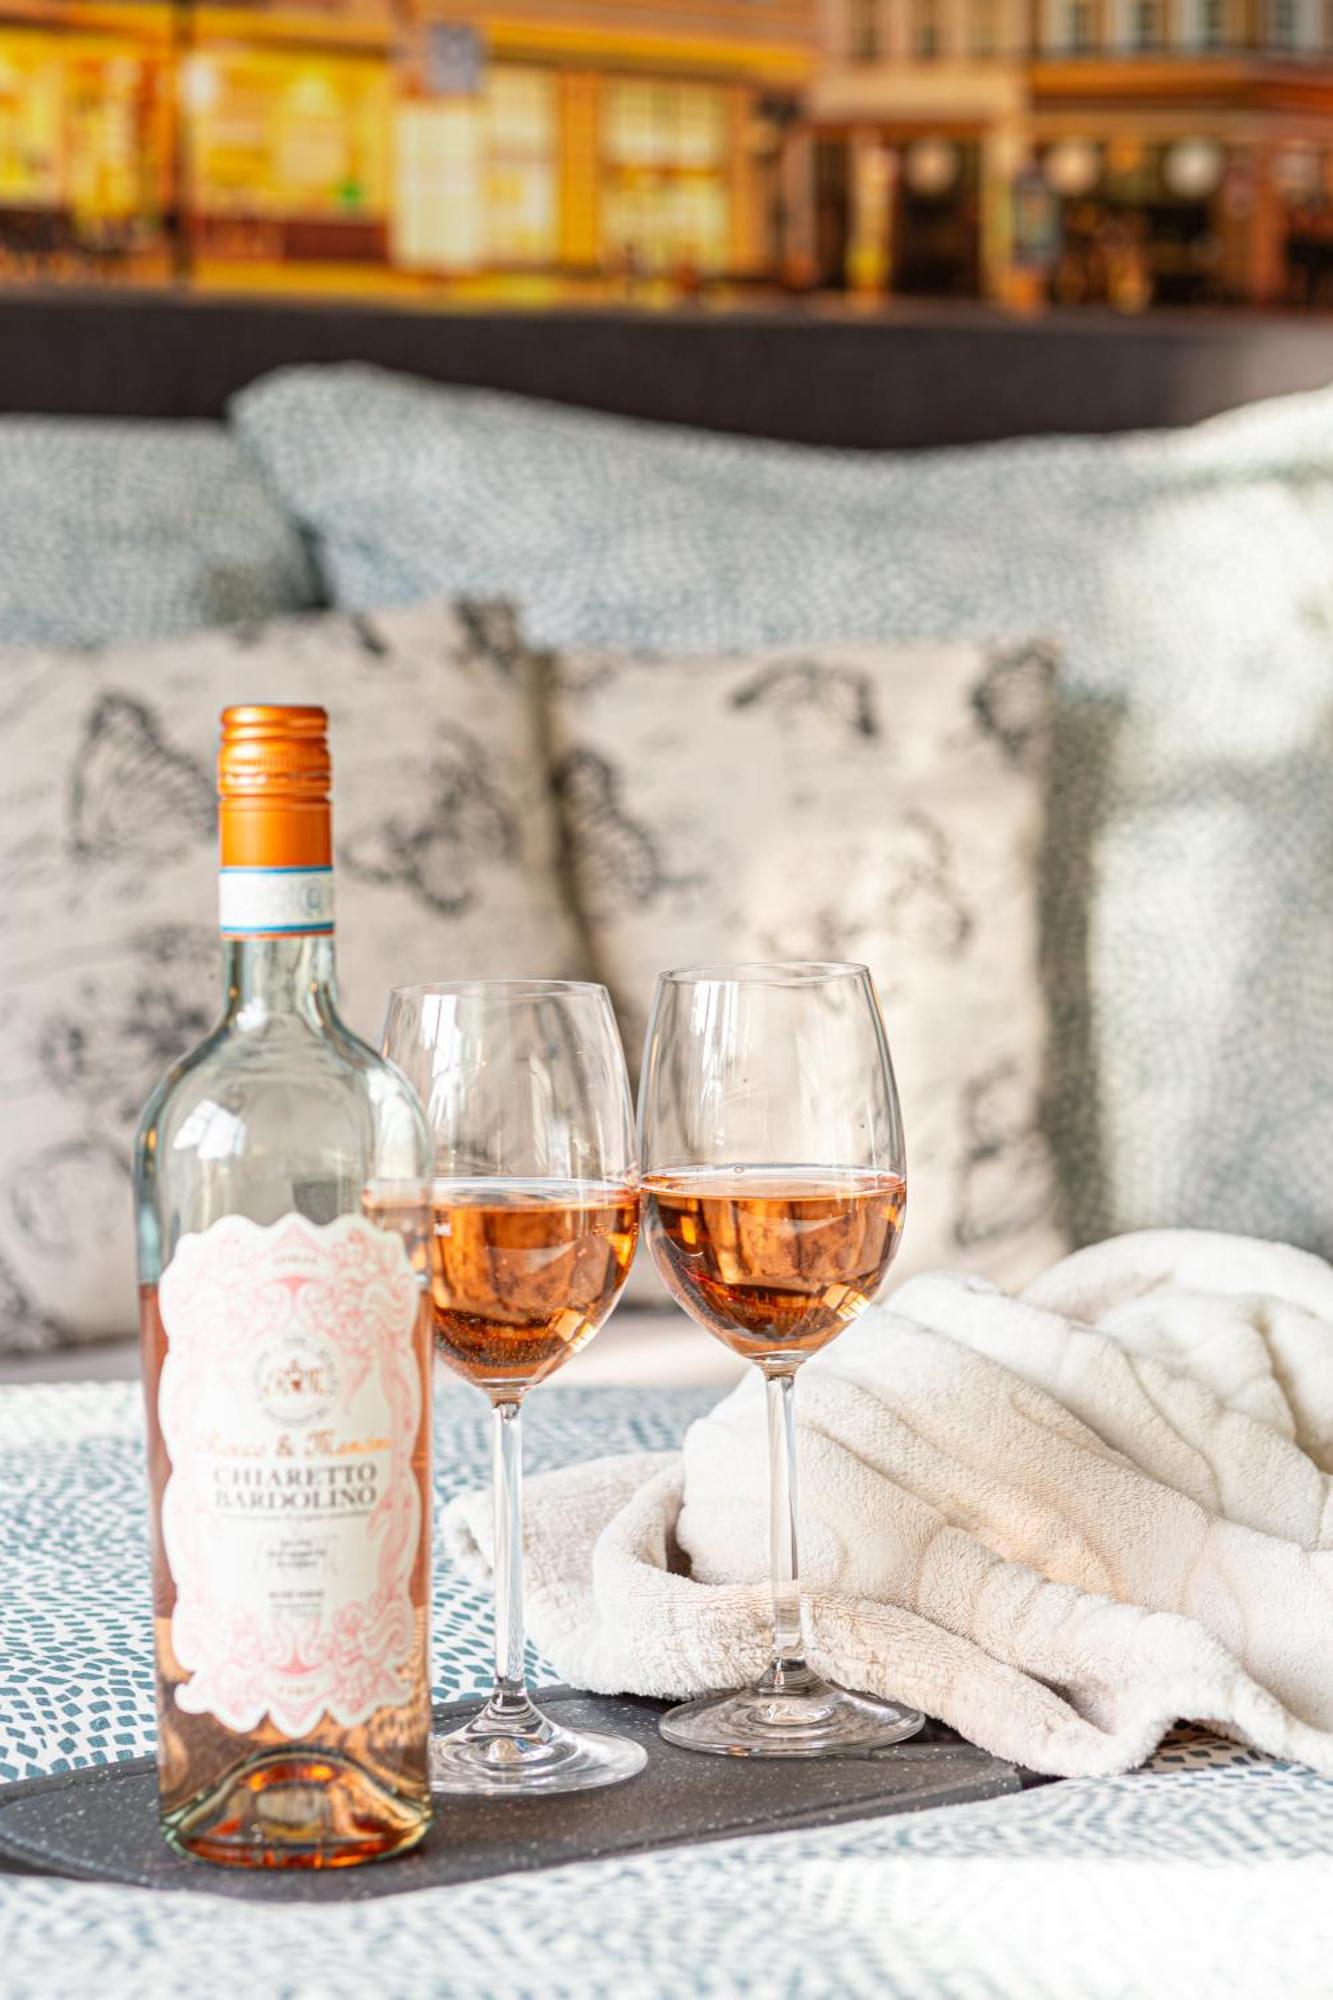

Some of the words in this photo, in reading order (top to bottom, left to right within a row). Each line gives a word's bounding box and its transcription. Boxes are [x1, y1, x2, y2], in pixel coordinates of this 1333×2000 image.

[276, 1432, 295, 1457] &
[213, 1463, 378, 1488] CHIARETTO
[214, 1486, 378, 1510] BARDOLINO
